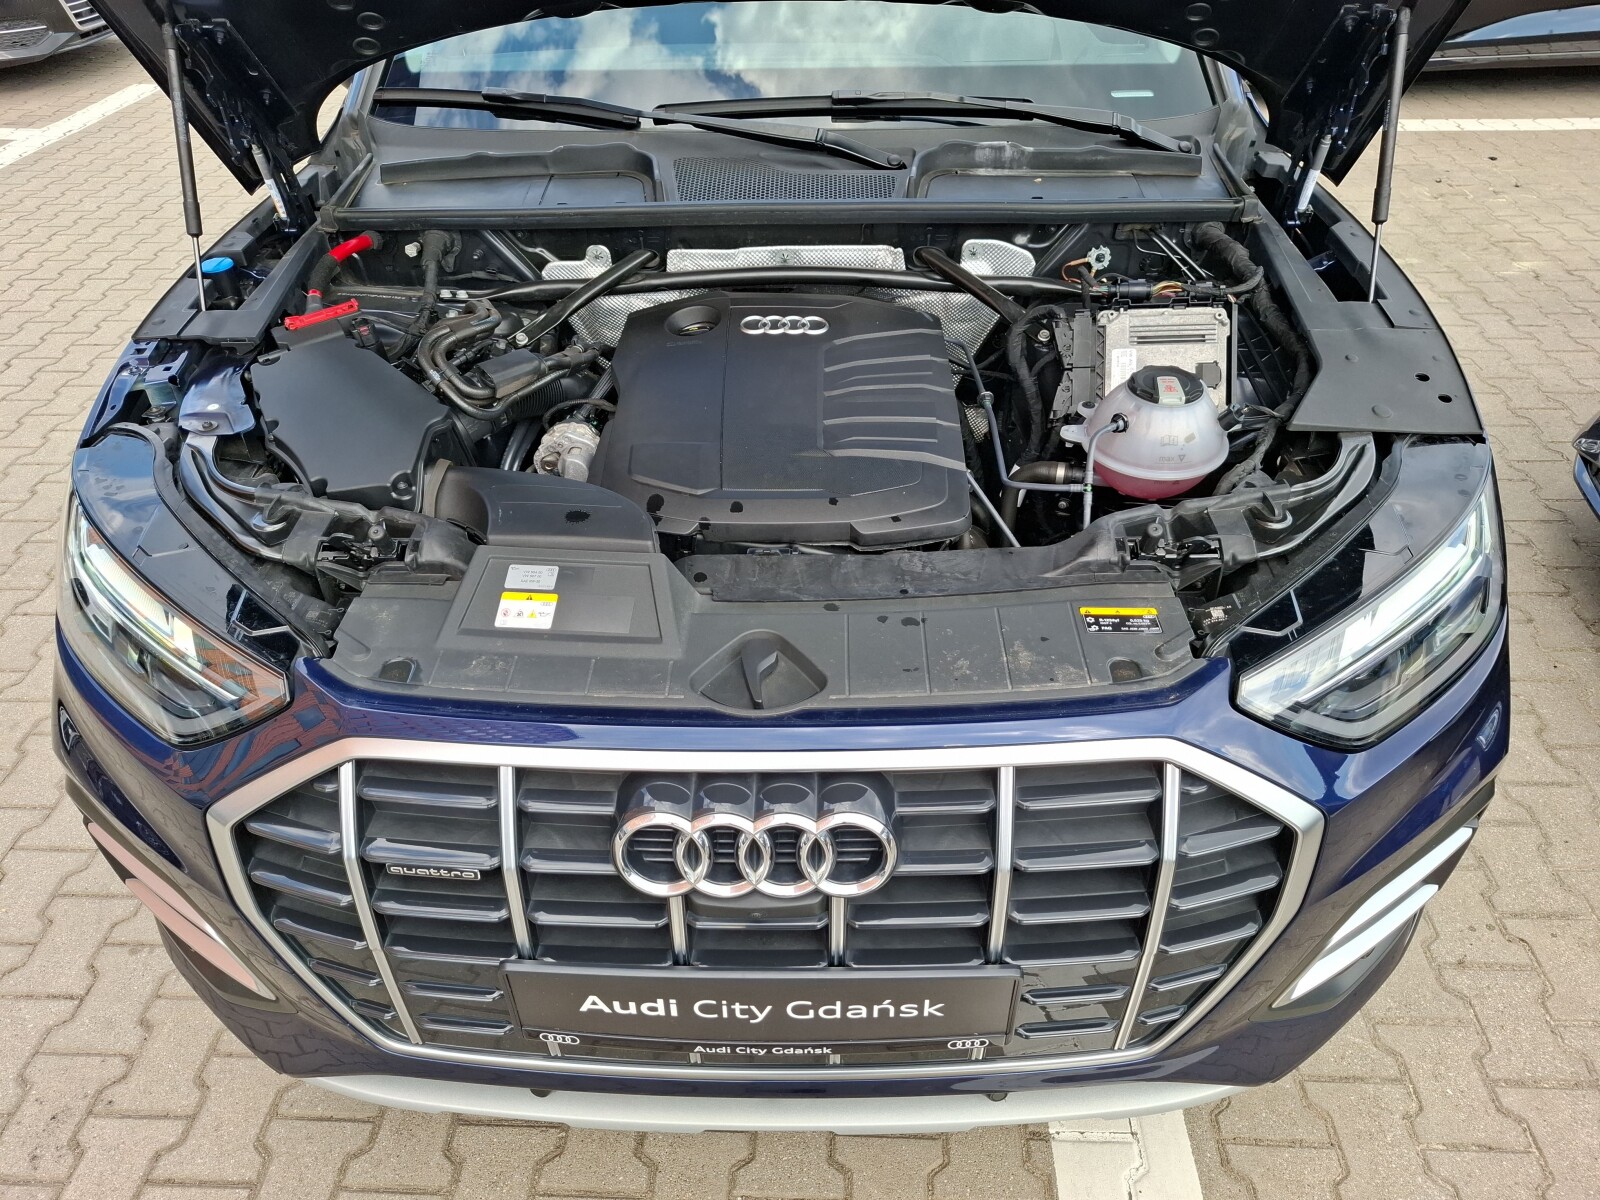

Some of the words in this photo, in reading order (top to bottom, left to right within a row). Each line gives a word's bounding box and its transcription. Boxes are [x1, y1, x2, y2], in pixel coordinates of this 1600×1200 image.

[390, 866, 475, 878] quattro
[579, 995, 679, 1017] Audi
[693, 1000, 773, 1023] City
[786, 1000, 946, 1019] Gdańsk
[693, 1045, 731, 1054] Audi
[735, 1046, 768, 1056] City
